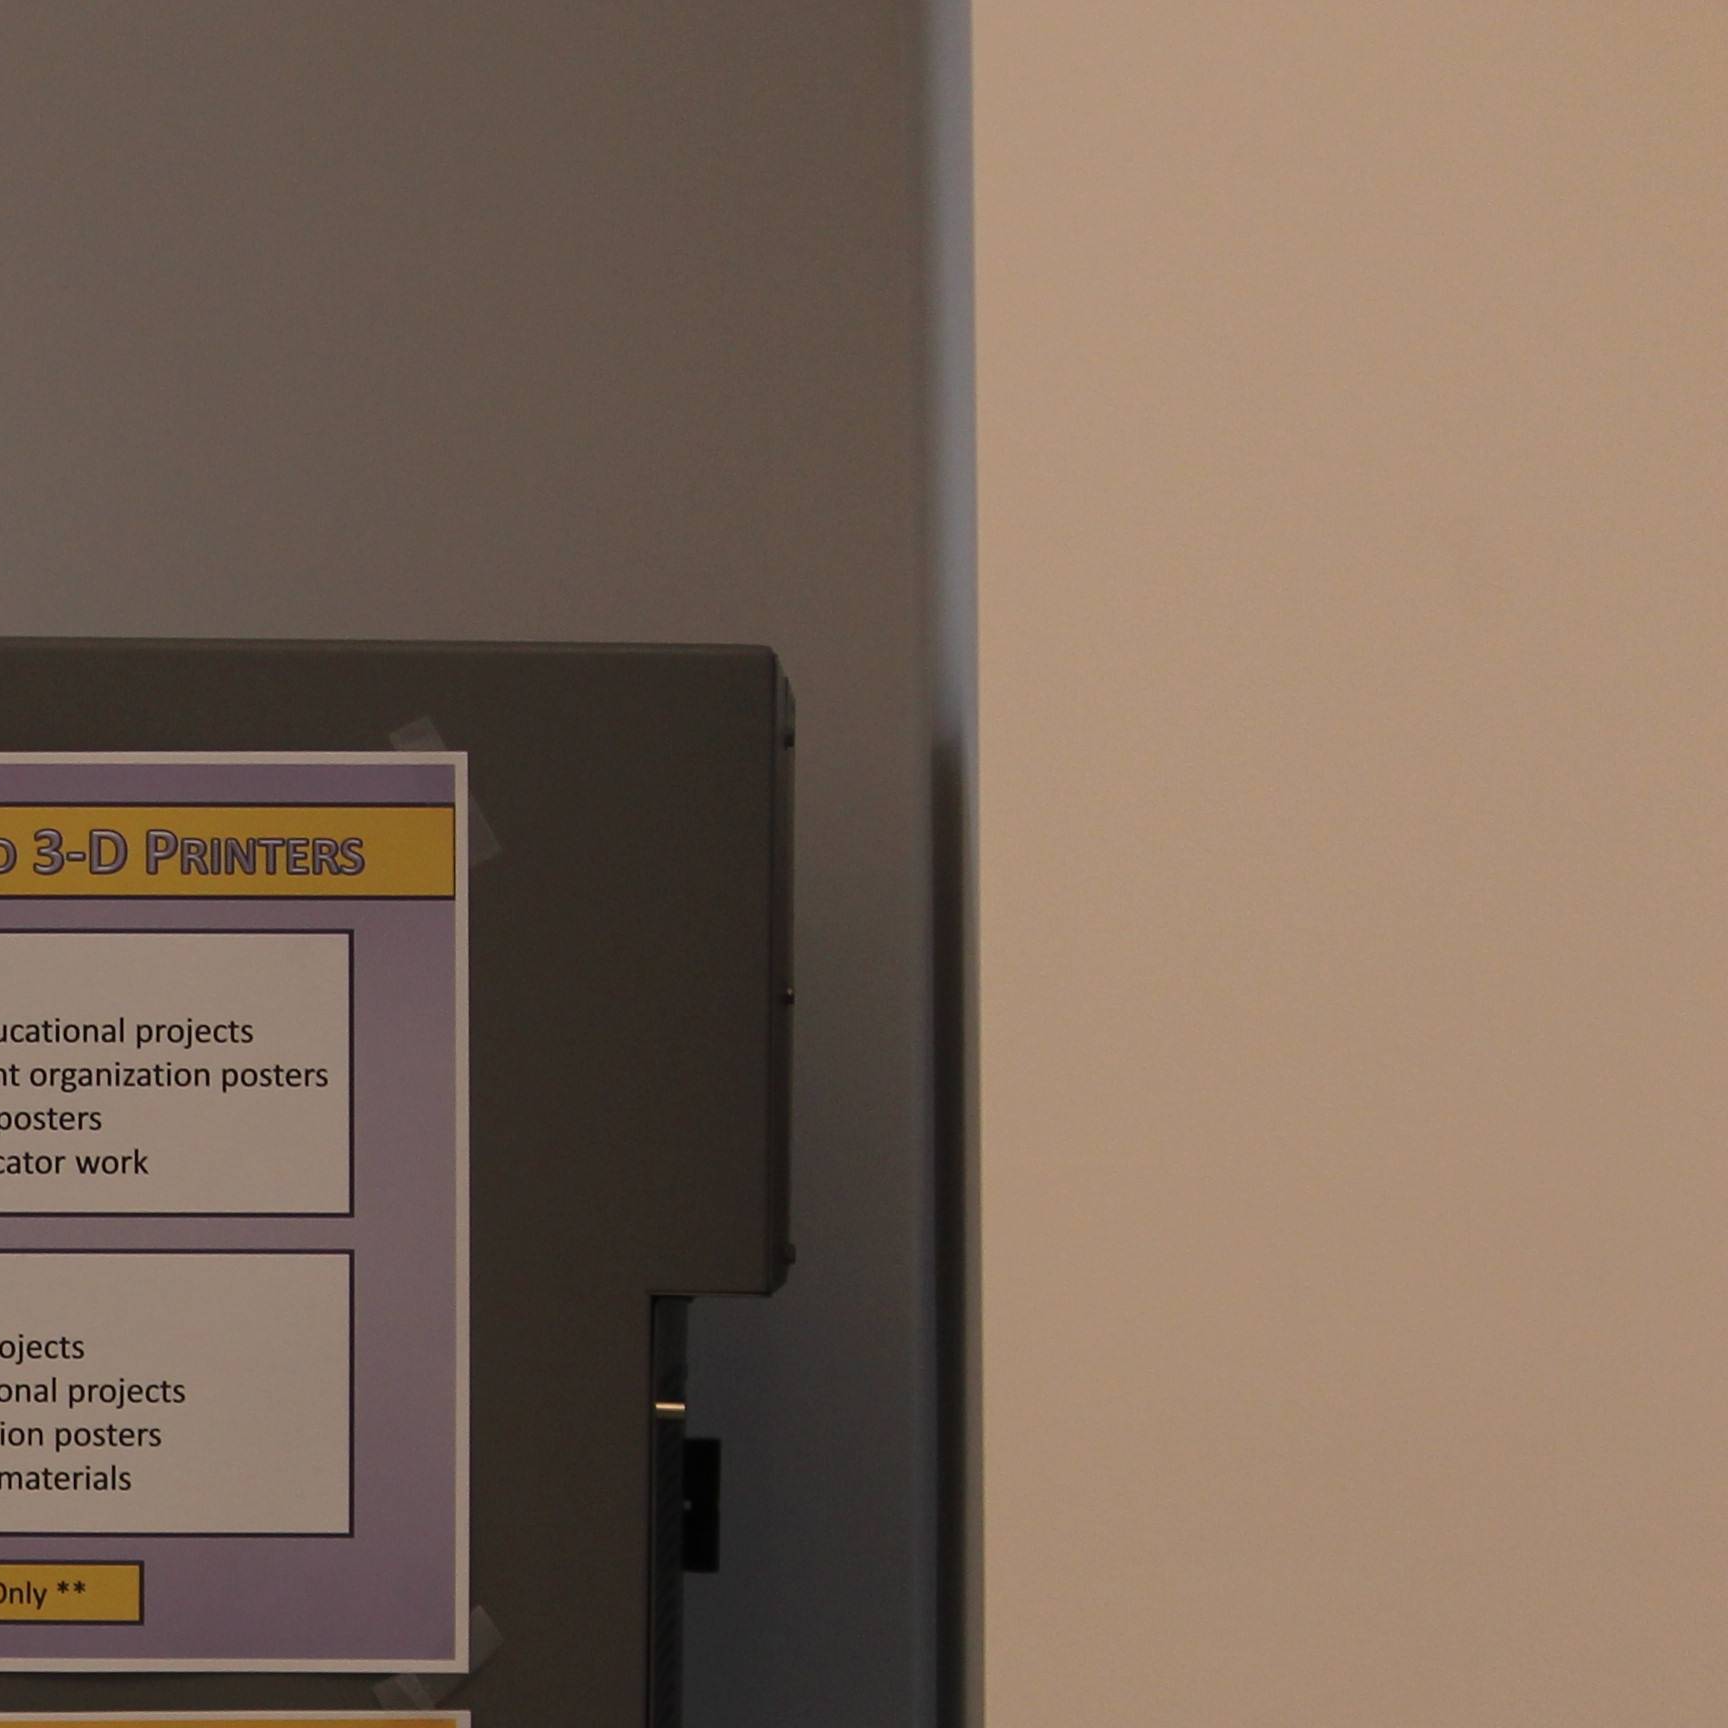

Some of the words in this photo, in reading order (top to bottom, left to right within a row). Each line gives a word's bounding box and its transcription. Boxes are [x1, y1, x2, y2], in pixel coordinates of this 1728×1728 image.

[32, 827, 129, 876] 3-D
[145, 828, 366, 877] PRINTERS
[136, 1017, 254, 1050] projects
[29, 1061, 211, 1094] organization
[221, 1064, 329, 1094] posters
[75, 1148, 149, 1175] work
[68, 1377, 186, 1410] projects
[55, 1423, 162, 1453] posters
